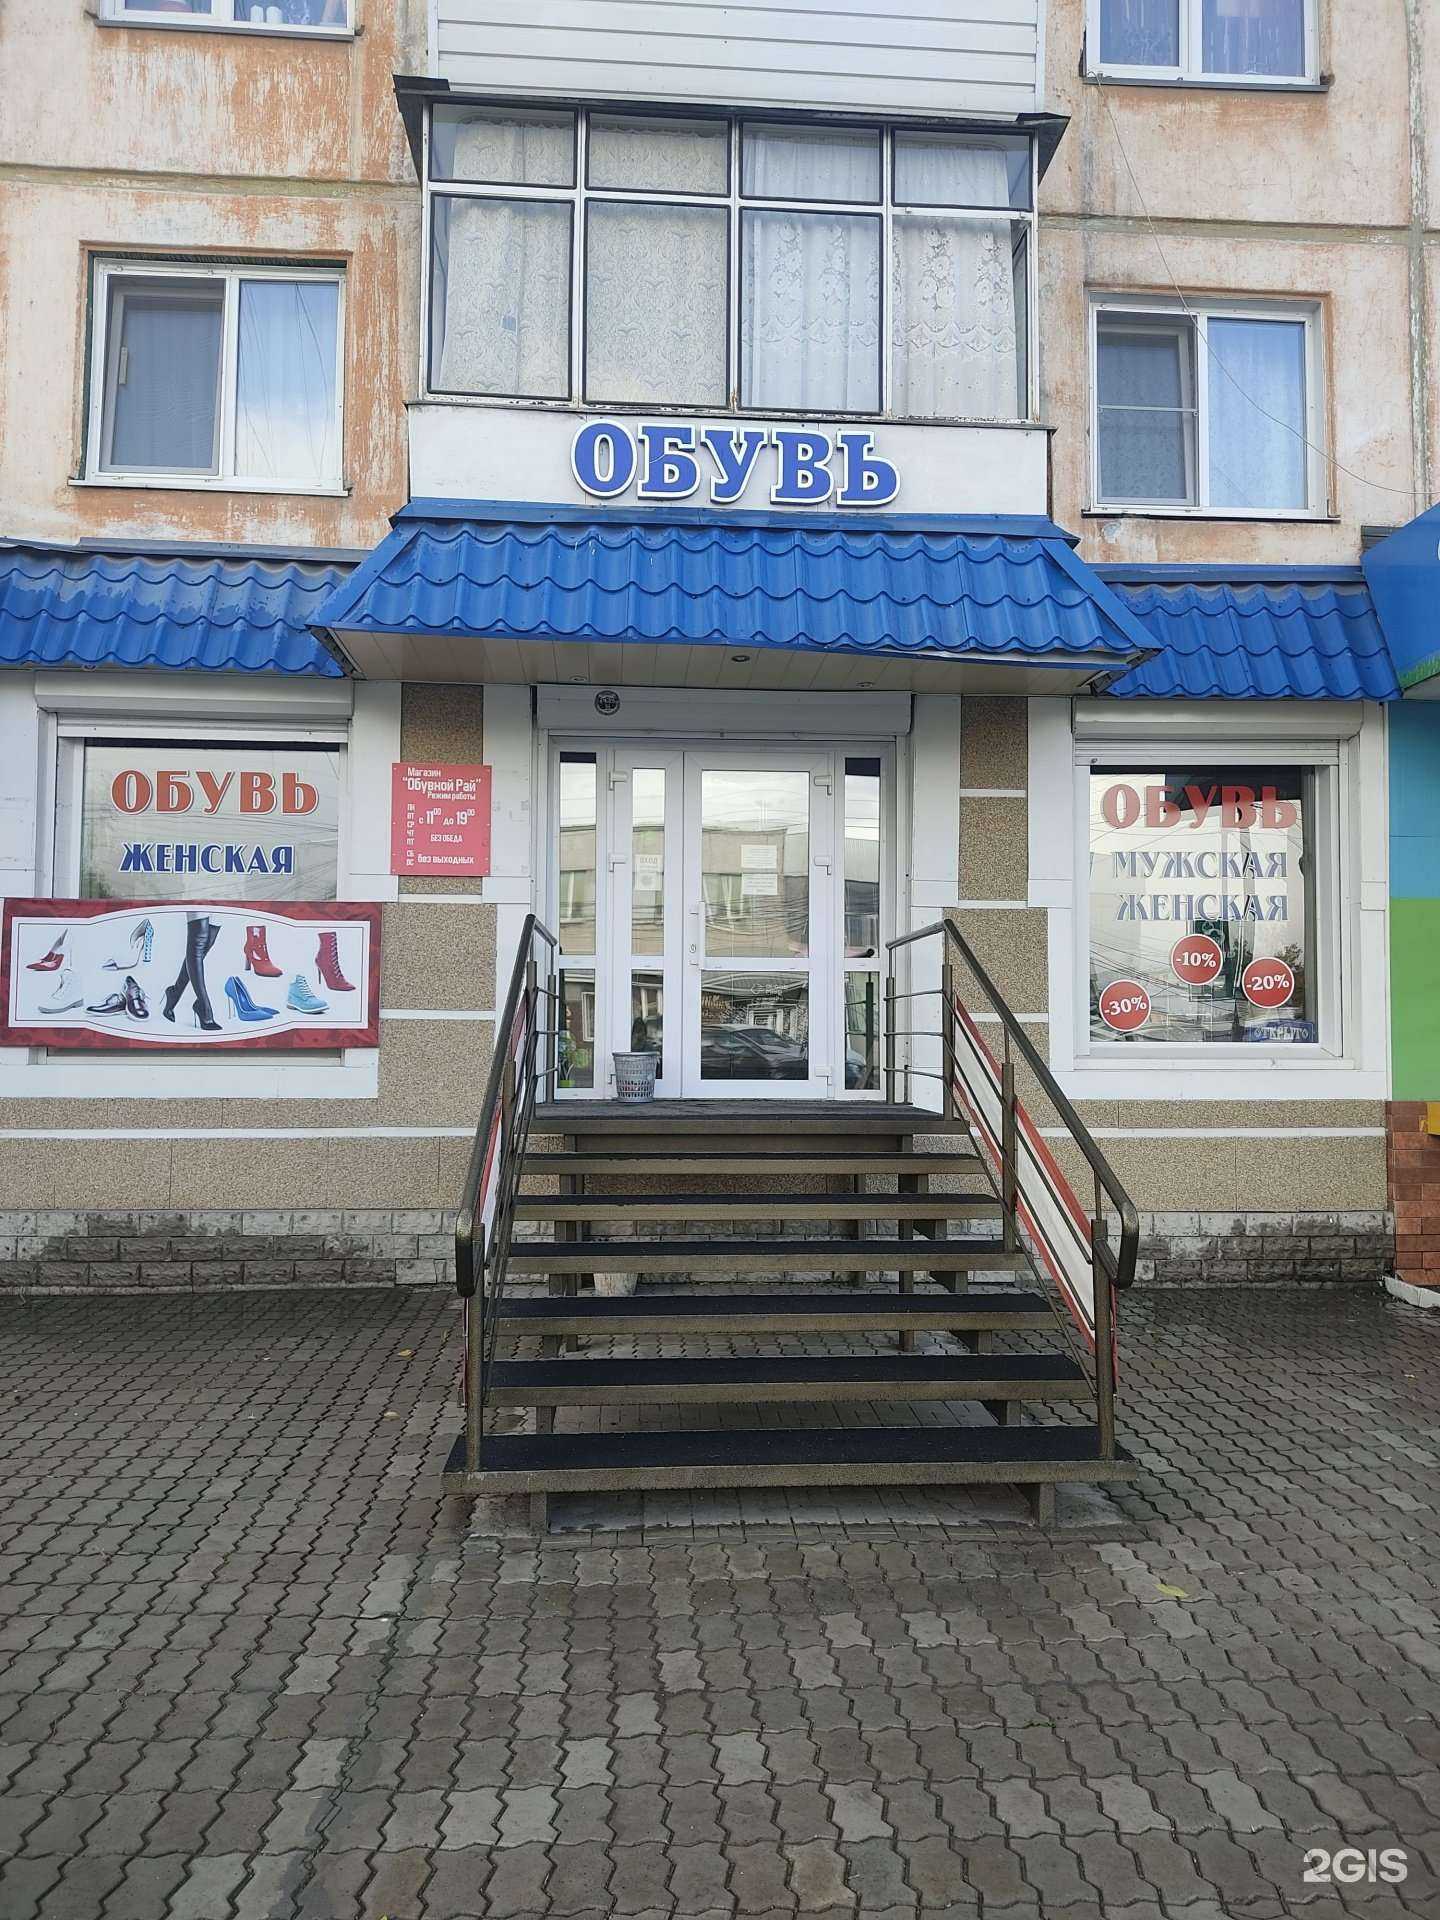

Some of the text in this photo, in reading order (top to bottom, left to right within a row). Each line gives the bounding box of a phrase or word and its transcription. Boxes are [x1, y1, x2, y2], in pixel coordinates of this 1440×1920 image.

[570, 418, 901, 506] ОБУВЬ
[407, 767, 441, 777] Магазин
[111, 769, 319, 815] ОБУВЬ
[1102, 783, 1298, 830] ОБУВЬ
[443, 817, 454, 826] до
[119, 842, 296, 875] ЖЕНСКАЯ
[1112, 851, 1289, 879] МУЖСКАЯ
[1116, 894, 1289, 921] ЖЕНСКАЯ
[1175, 951, 1217, 968] -10%
[1246, 974, 1290, 991] -20%
[1104, 995, 1147, 1015] -30%
